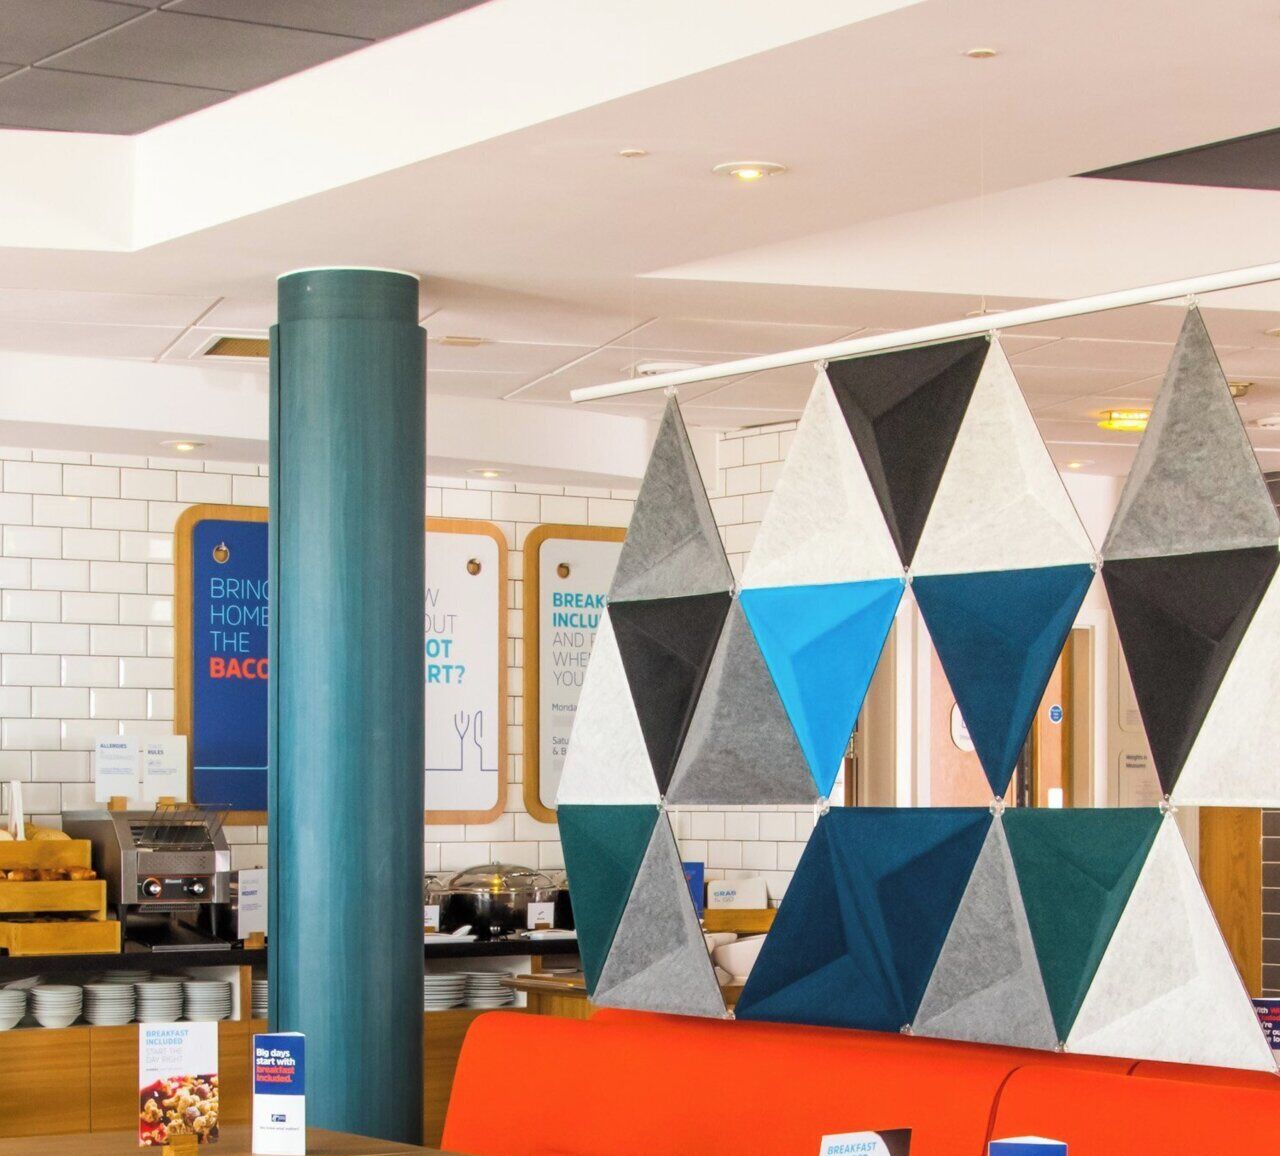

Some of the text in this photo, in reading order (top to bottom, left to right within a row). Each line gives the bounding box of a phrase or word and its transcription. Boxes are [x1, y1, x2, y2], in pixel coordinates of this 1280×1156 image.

[553, 592, 607, 609] BREAK
[552, 613, 599, 629] INCLU
[209, 631, 250, 653] THE
[552, 632, 584, 648] AND
[427, 664, 465, 684] RT?
[145, 1029, 189, 1038] BREAKFAST
[145, 1037, 184, 1046] INCLUDED
[256, 1048, 291, 1058] Big days
[256, 1057, 296, 1066] start with
[827, 1141, 878, 1156] BREAKFAST
